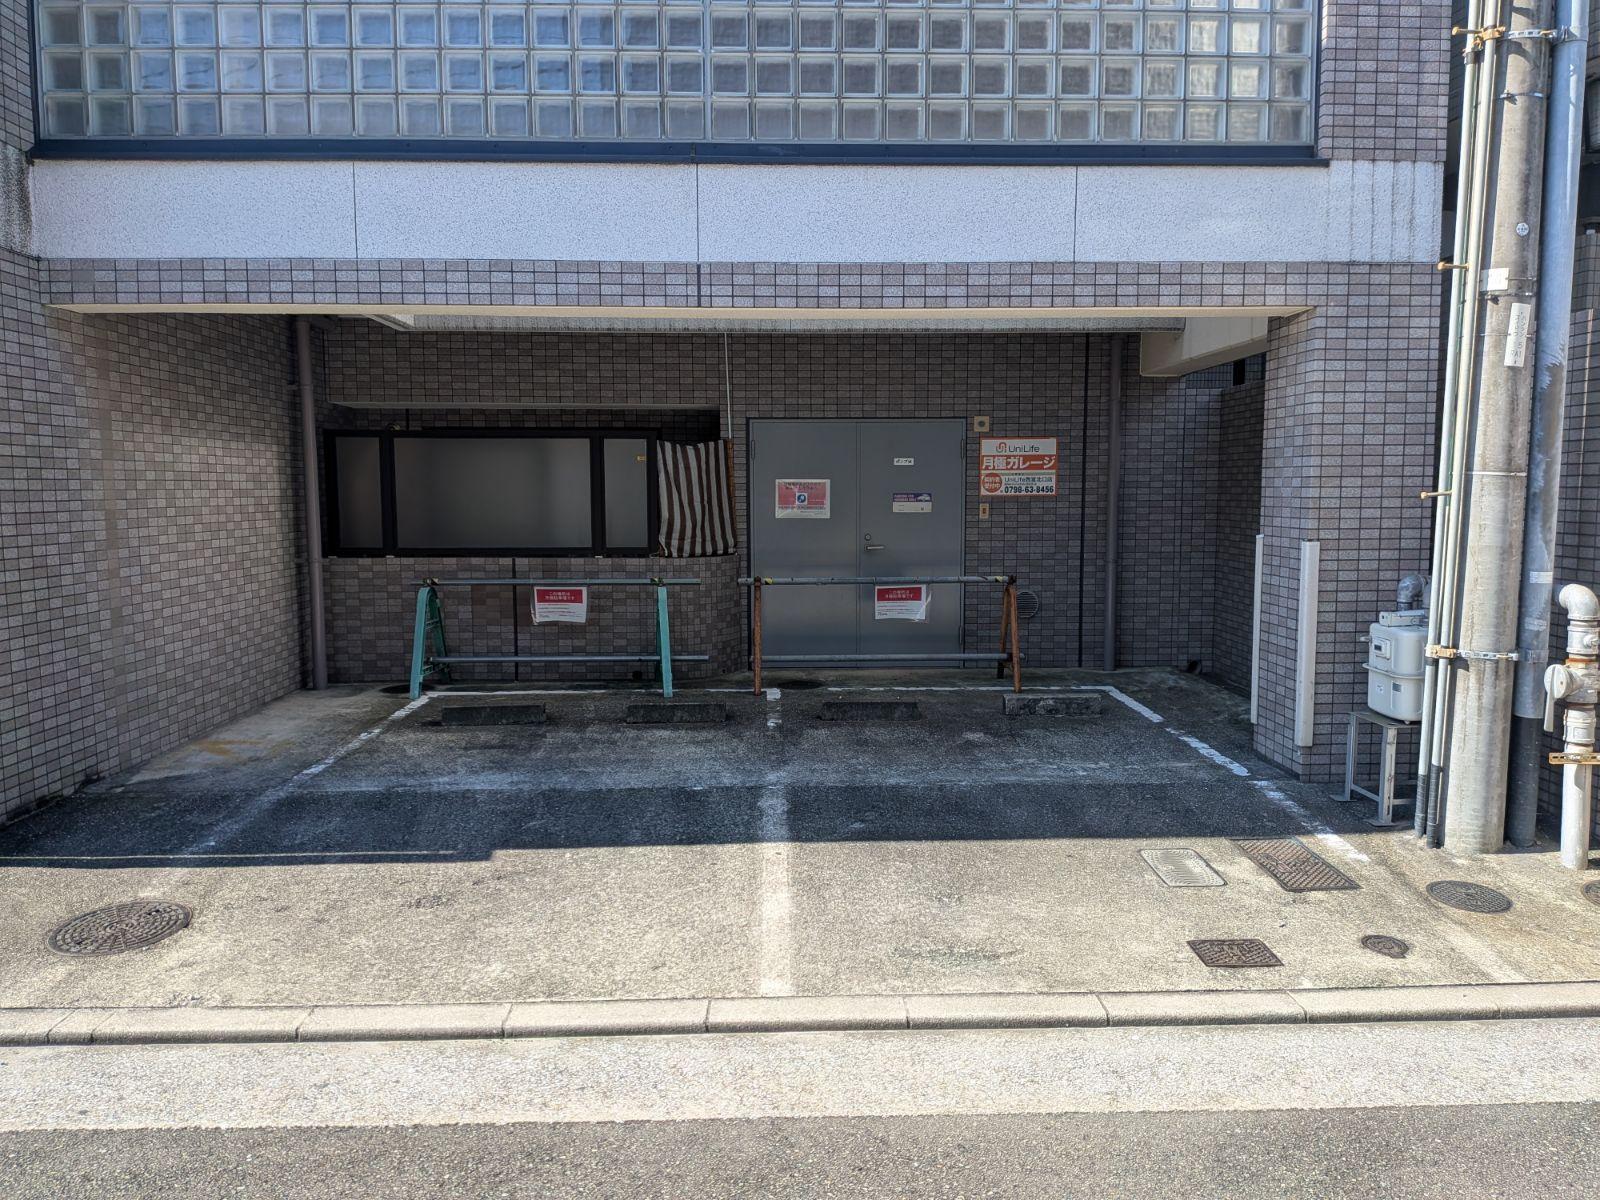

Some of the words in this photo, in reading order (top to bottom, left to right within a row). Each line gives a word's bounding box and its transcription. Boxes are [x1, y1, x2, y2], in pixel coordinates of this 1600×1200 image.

[1008, 444, 1040, 453] UniLife
[982, 455, 1056, 470] 月極ガレージ
[1004, 485, 1054, 494] 0798-63-8456
